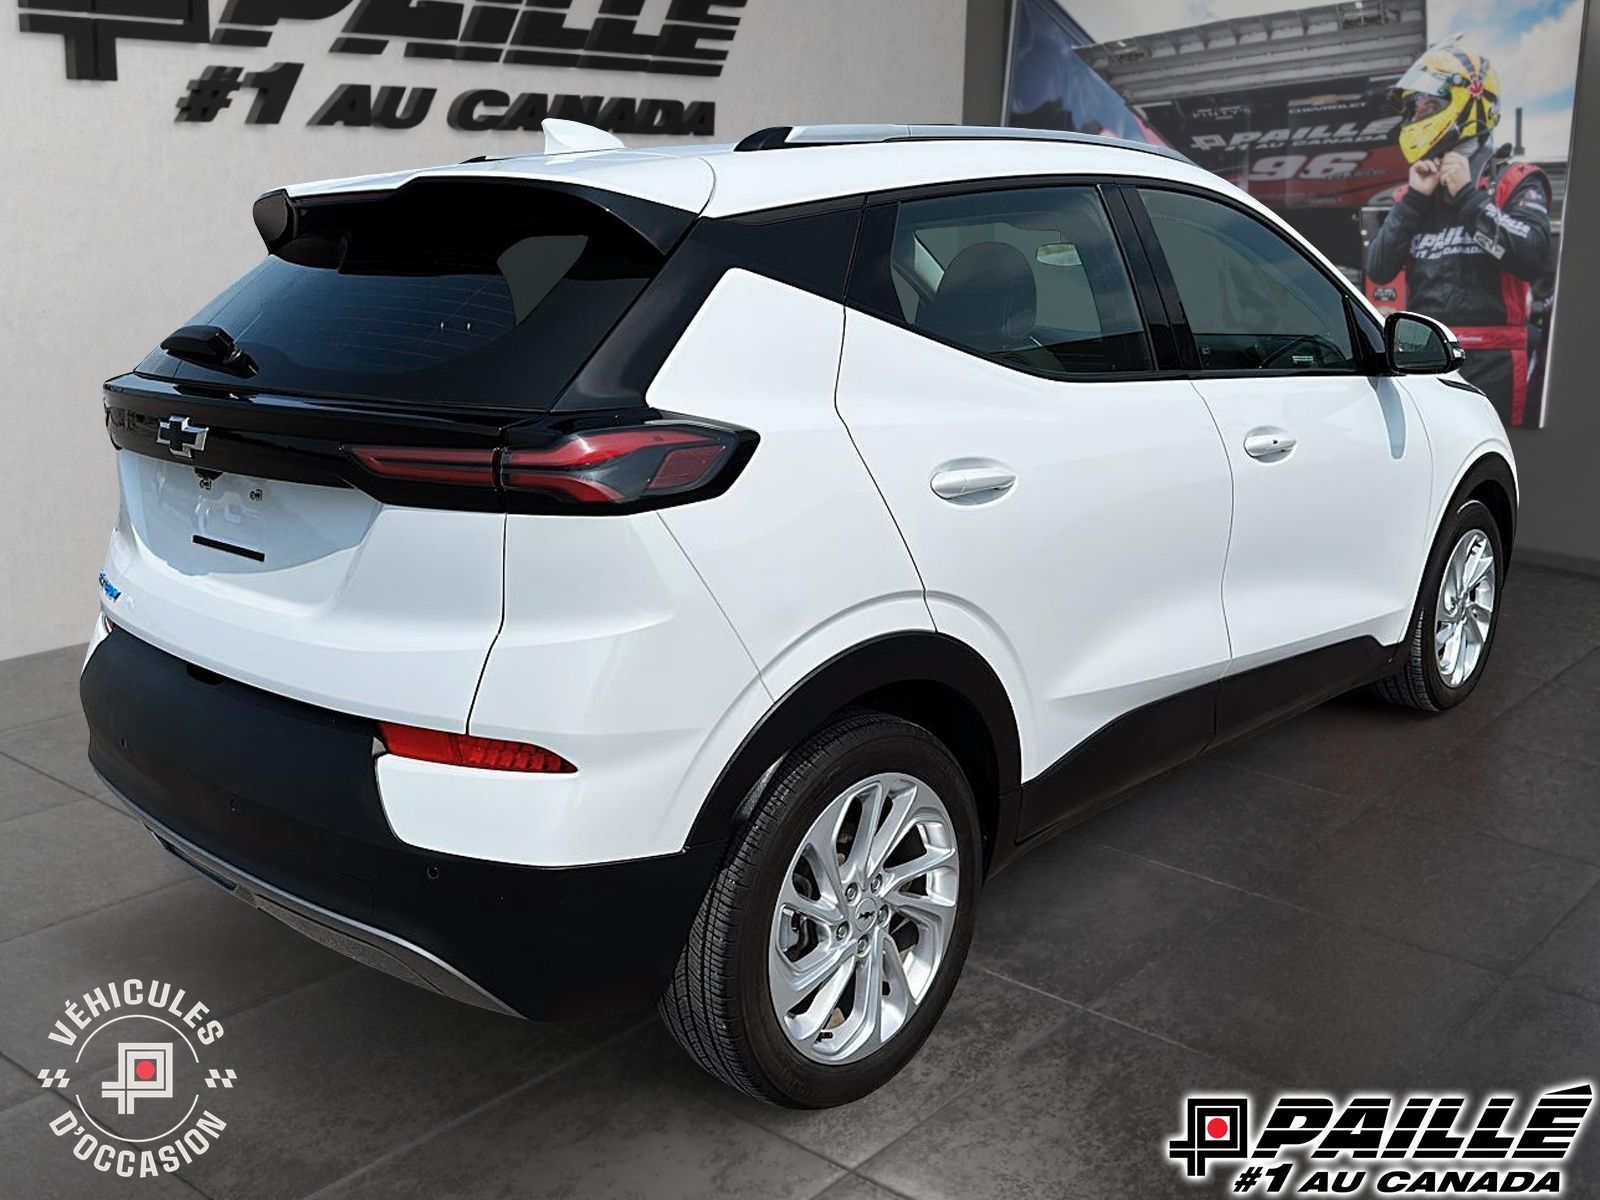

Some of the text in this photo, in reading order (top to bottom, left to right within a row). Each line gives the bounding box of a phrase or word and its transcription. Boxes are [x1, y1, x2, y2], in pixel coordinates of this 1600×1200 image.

[174, 62, 716, 136] #1 AU CANADA
[1288, 102, 1367, 114] CHEVROLET
[1257, 141, 1284, 149] AU
[1291, 133, 1388, 146] CANADA
[1251, 151, 1368, 181] 96
